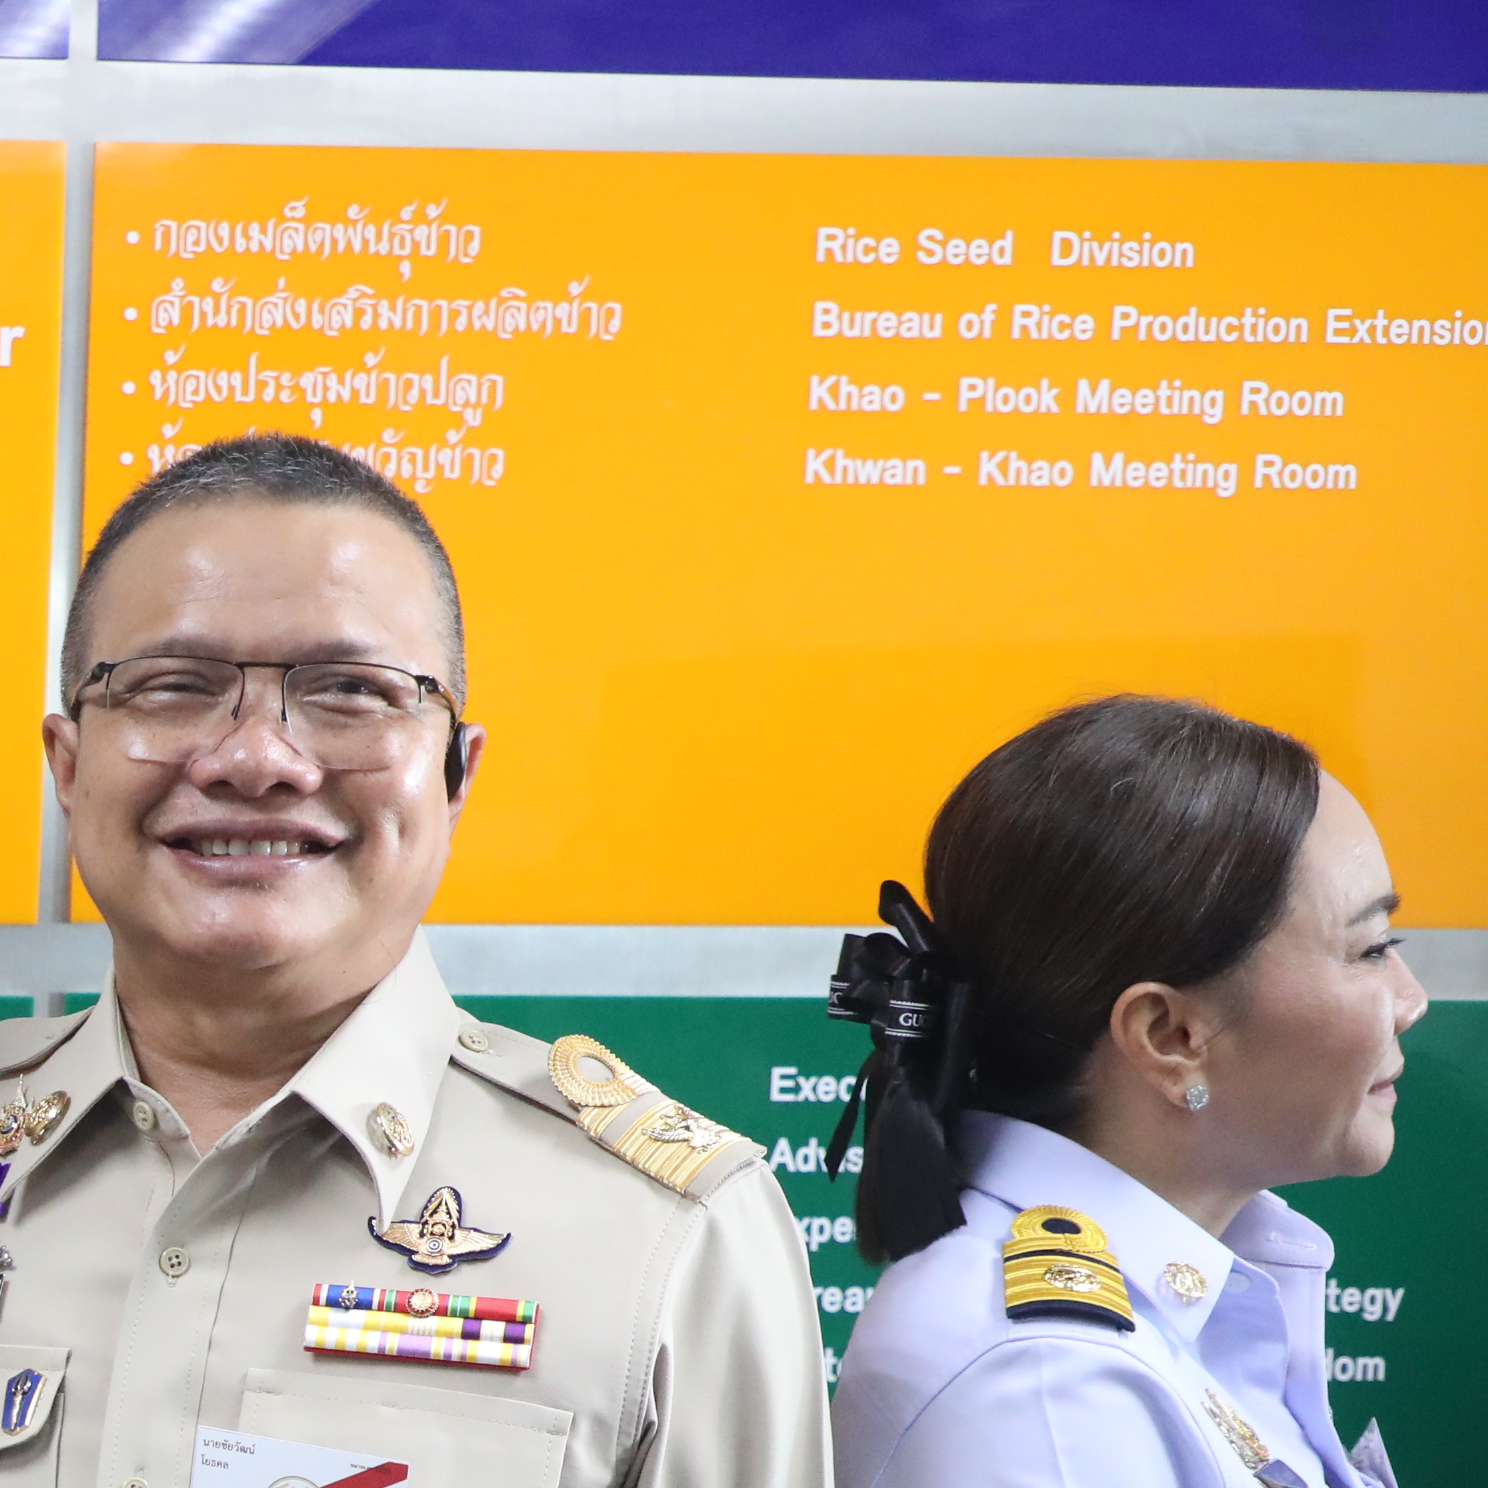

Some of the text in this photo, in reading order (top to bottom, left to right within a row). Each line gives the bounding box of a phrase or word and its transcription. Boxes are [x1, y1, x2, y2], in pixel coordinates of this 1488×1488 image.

[154, 198, 481, 279] กองเมล็ดพันธุ์ข้าว
[816, 227, 1195, 268] Rice Seed Division
[151, 276, 622, 341] สำนักส่งเสริมการผลิตข้าว
[812, 301, 1488, 346] Bureau of Rice Production Extensio
[149, 347, 504, 427] ห้องประชุมข้าวปลูก
[809, 375, 905, 412] Khao
[958, 377, 1060, 413] Plook
[1076, 378, 1225, 425] Meeting
[1240, 380, 1344, 416] Room
[805, 448, 926, 485] Khwan
[978, 451, 1074, 487] Khao
[1090, 452, 1238, 498] Meeting
[1254, 454, 1358, 490] Room
[770, 1066, 867, 1102] Exec
[1325, 1278, 1405, 1322] tegy
[203, 1438, 256, 1455] นายชัยวัฒน์
